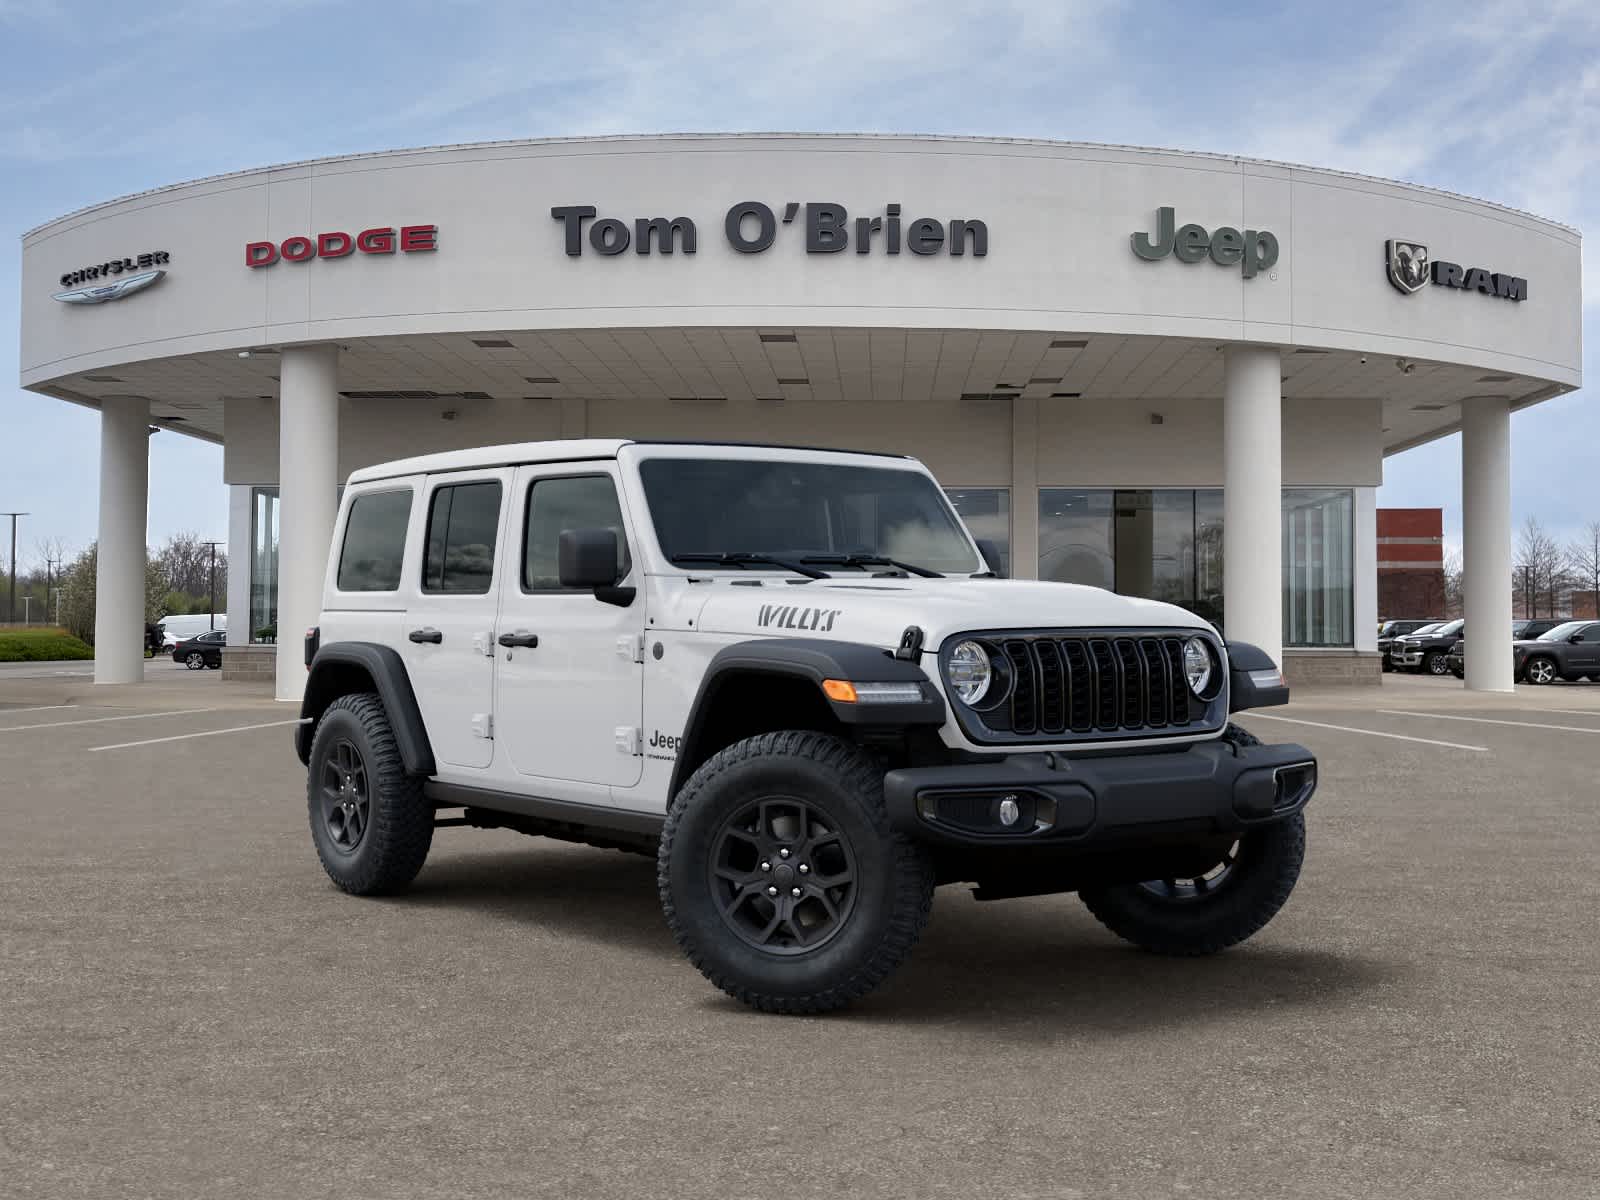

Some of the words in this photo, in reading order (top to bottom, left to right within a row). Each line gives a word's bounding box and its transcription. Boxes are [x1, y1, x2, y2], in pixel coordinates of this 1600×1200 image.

[246, 225, 438, 269] DODGE
[551, 205, 697, 257] Tom
[725, 201, 988, 257] O'Brien
[1130, 206, 1279, 279] Jeep
[60, 251, 169, 286] CHRYSLER
[1431, 260, 1528, 301] RAM
[758, 604, 842, 631] WILLYS
